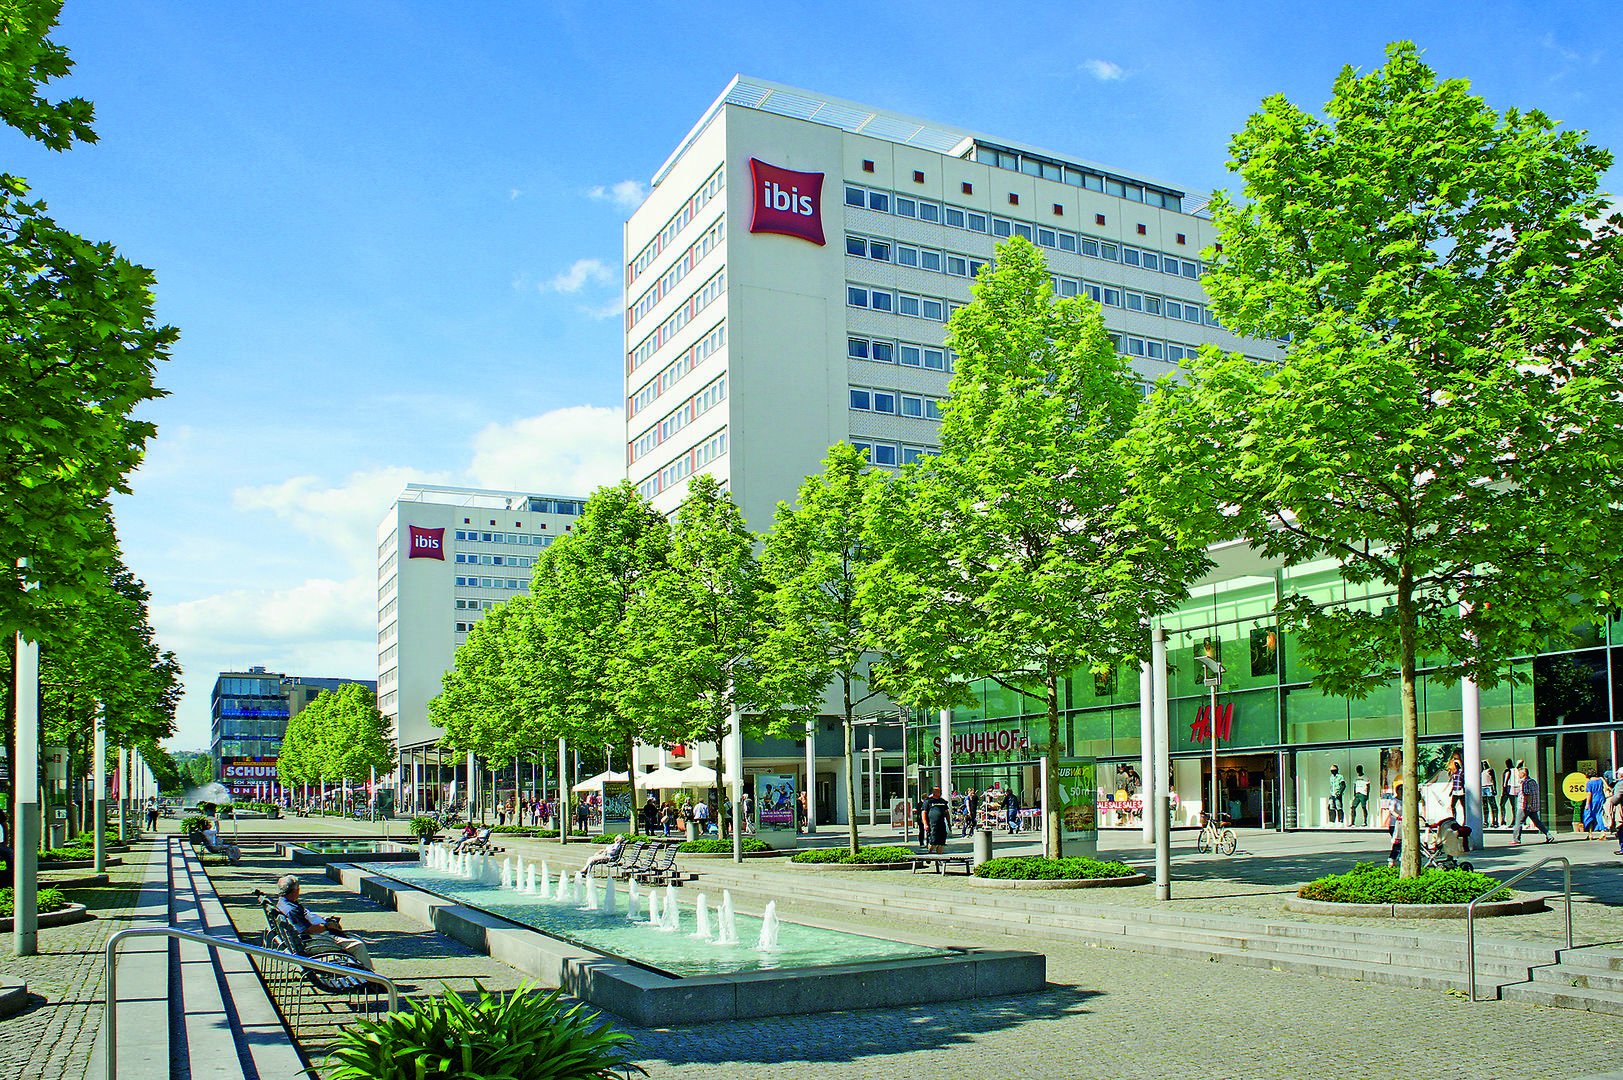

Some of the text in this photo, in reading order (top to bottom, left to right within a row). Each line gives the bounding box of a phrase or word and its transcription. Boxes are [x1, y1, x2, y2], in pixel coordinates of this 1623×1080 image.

[764, 180, 814, 217] ibis
[415, 534, 440, 549] ibis
[1190, 702, 1234, 744] H&M
[933, 728, 1020, 756] SHUHHOF
[226, 766, 280, 777] SCHUH
[1108, 801, 1122, 809] SALE
